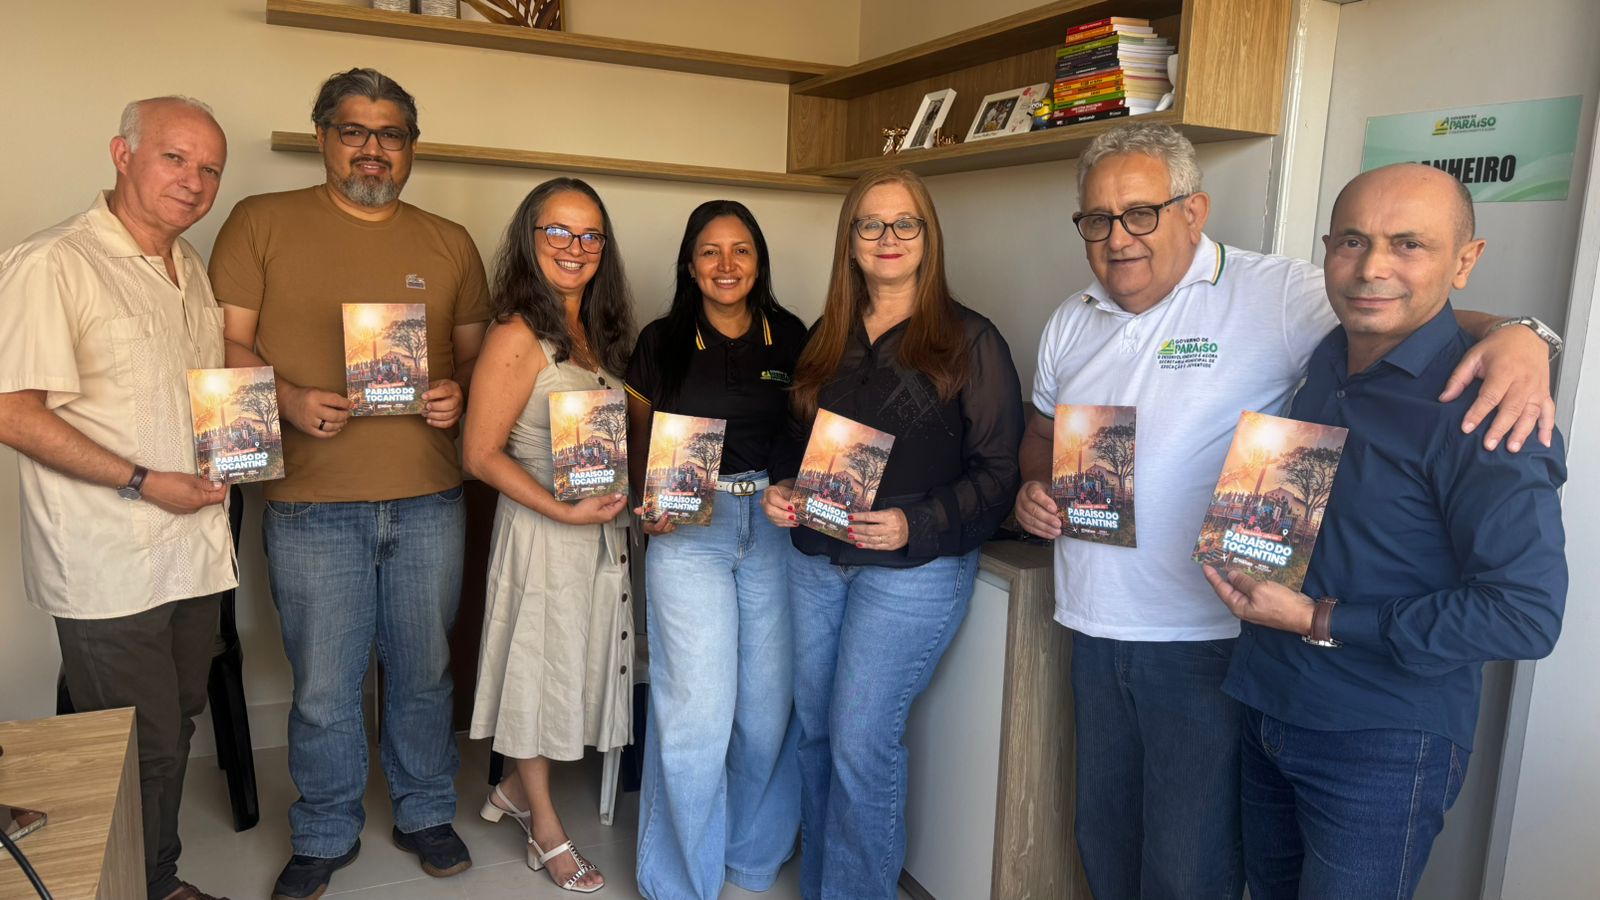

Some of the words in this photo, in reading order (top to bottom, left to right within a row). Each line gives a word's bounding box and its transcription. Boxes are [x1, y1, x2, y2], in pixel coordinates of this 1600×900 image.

[1416, 155, 1516, 183] HEIRO
[216, 460, 267, 471] TOCANTINS
[570, 476, 614, 486] TOCANTINS
[658, 501, 699, 512] TOCANTINS
[806, 504, 849, 527] TOCANTINS
[1106, 512, 1119, 520] DO
[1068, 516, 1118, 528] TOCANTINS
[1223, 539, 1287, 566] TOCANTINS
[1275, 544, 1292, 556] DO
